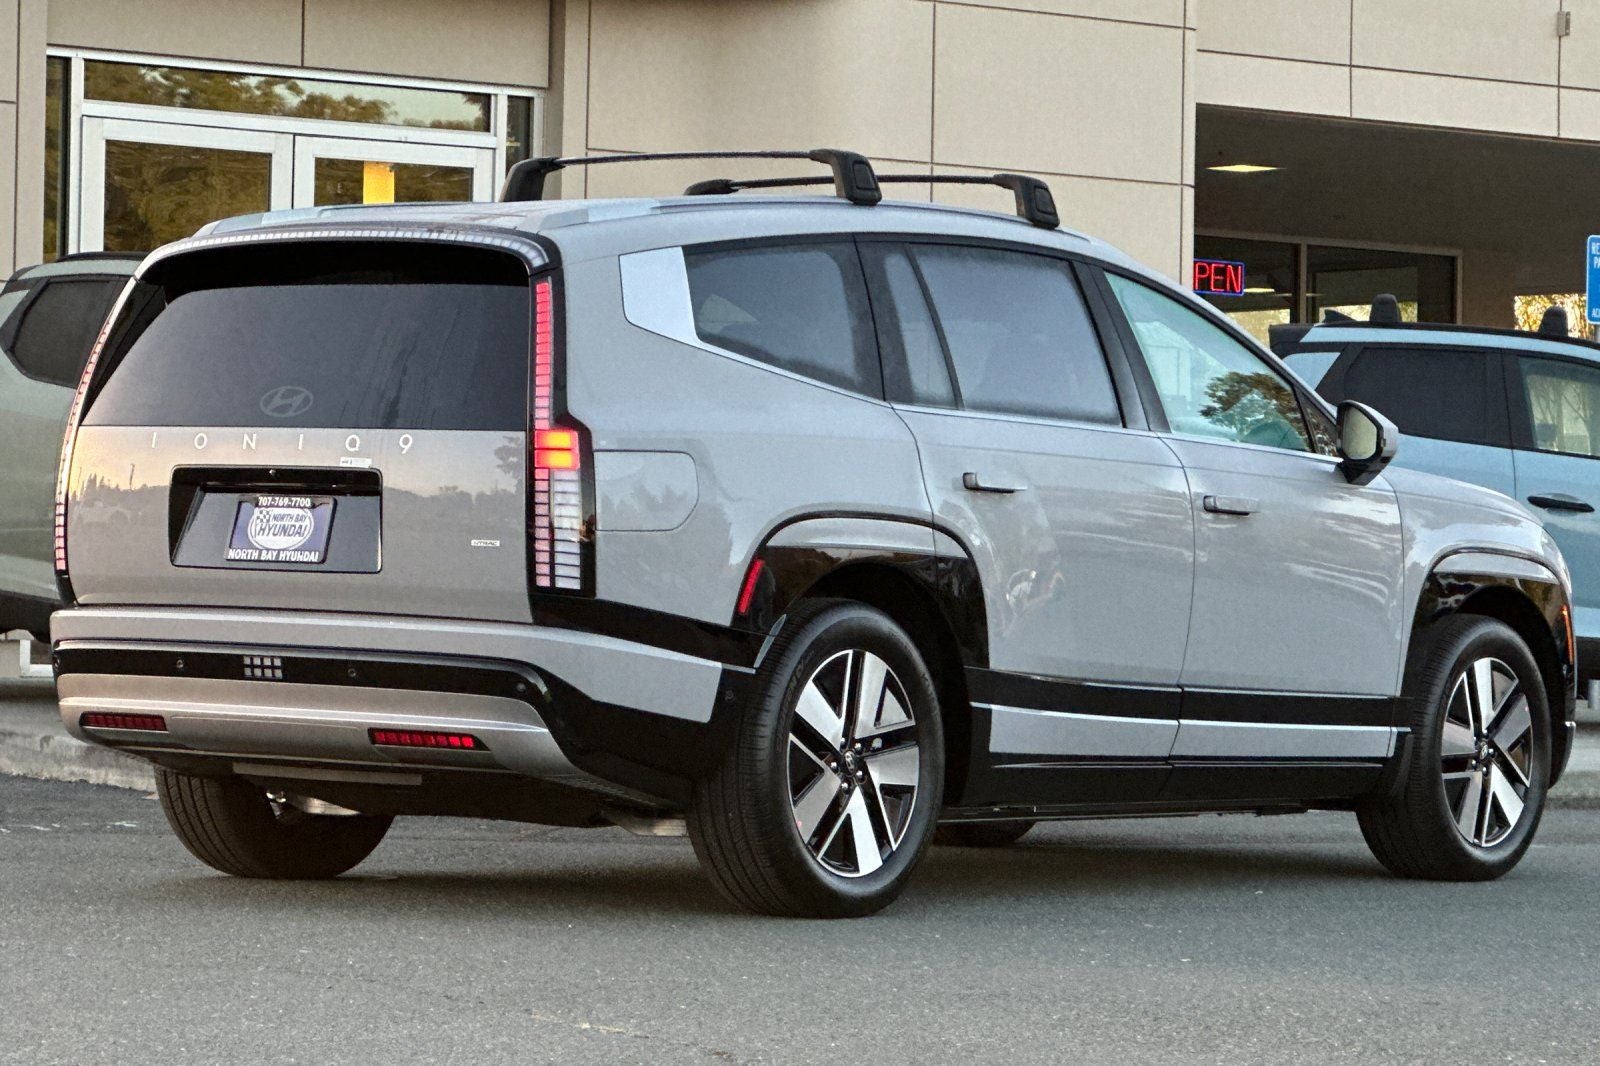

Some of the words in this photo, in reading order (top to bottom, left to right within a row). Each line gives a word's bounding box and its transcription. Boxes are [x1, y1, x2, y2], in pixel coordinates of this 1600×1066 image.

[1193, 261, 1242, 293] PEN
[399, 433, 413, 454] 9
[258, 496, 311, 507] 707-769-7700
[271, 513, 295, 523] NORTH
[295, 513, 309, 523] BAY
[257, 523, 309, 537] HYUNDAI
[228, 548, 258, 560] NORTH
[260, 550, 278, 561] BAY
[279, 550, 319, 562] HYUNDAI
